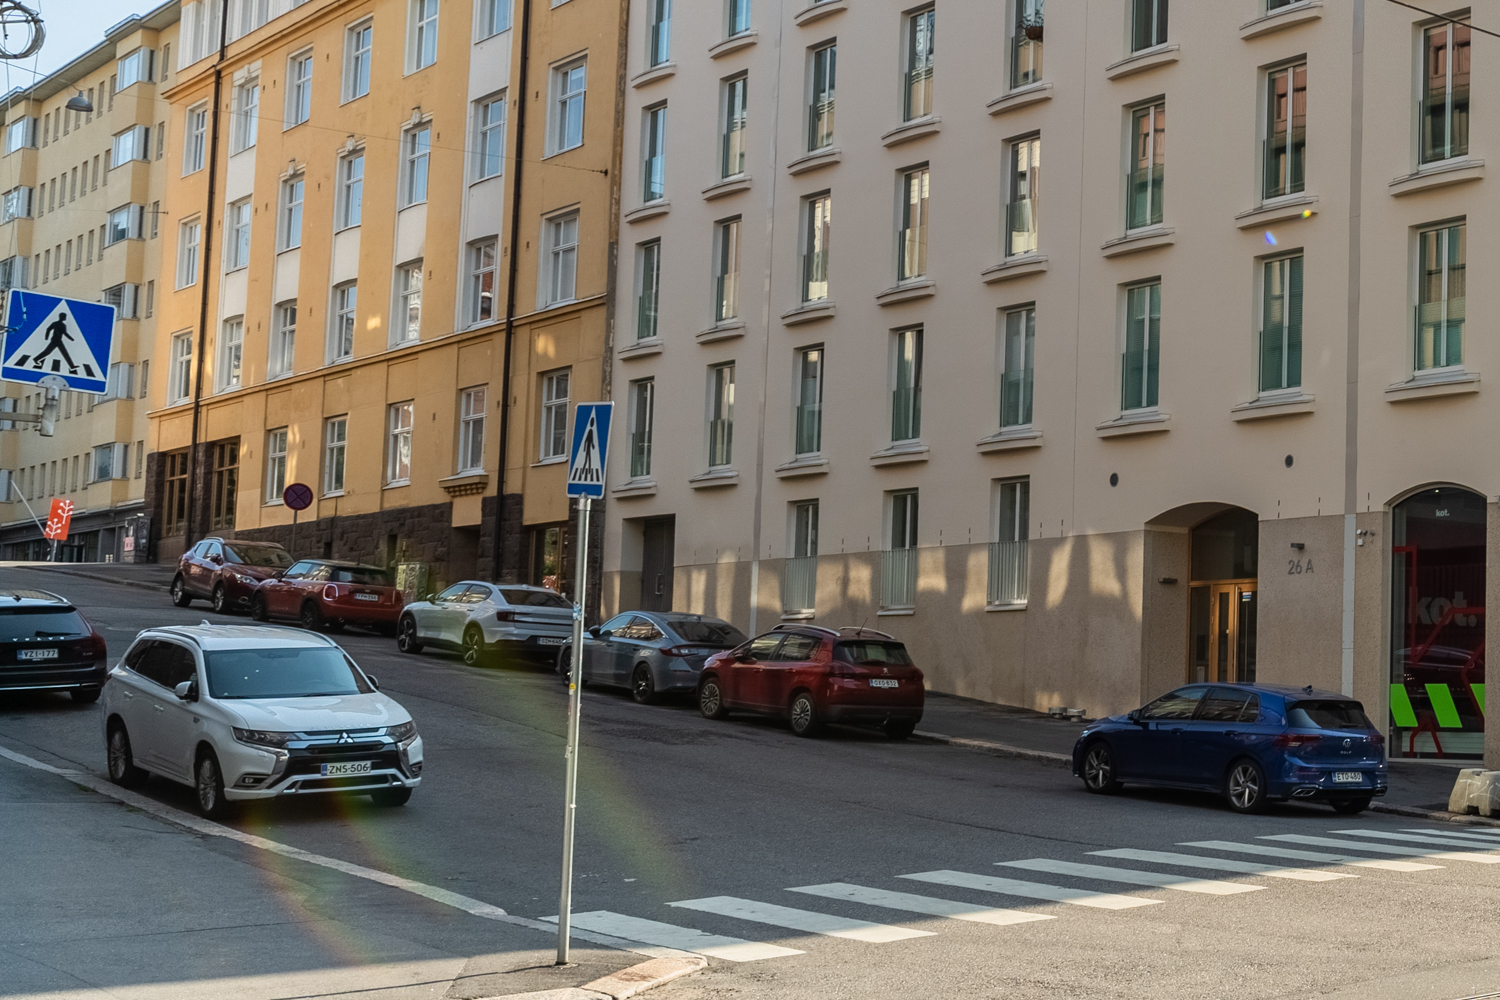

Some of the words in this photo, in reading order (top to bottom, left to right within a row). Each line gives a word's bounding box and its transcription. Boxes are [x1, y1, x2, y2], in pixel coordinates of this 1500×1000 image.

[1435, 509, 1450, 517] kot.
[1287, 559, 1303, 575] 26
[1305, 558, 1314, 574] A
[1408, 586, 1478, 628] kot.
[24, 649, 58, 659] VZI-177
[328, 763, 371, 775] ZNS-506
